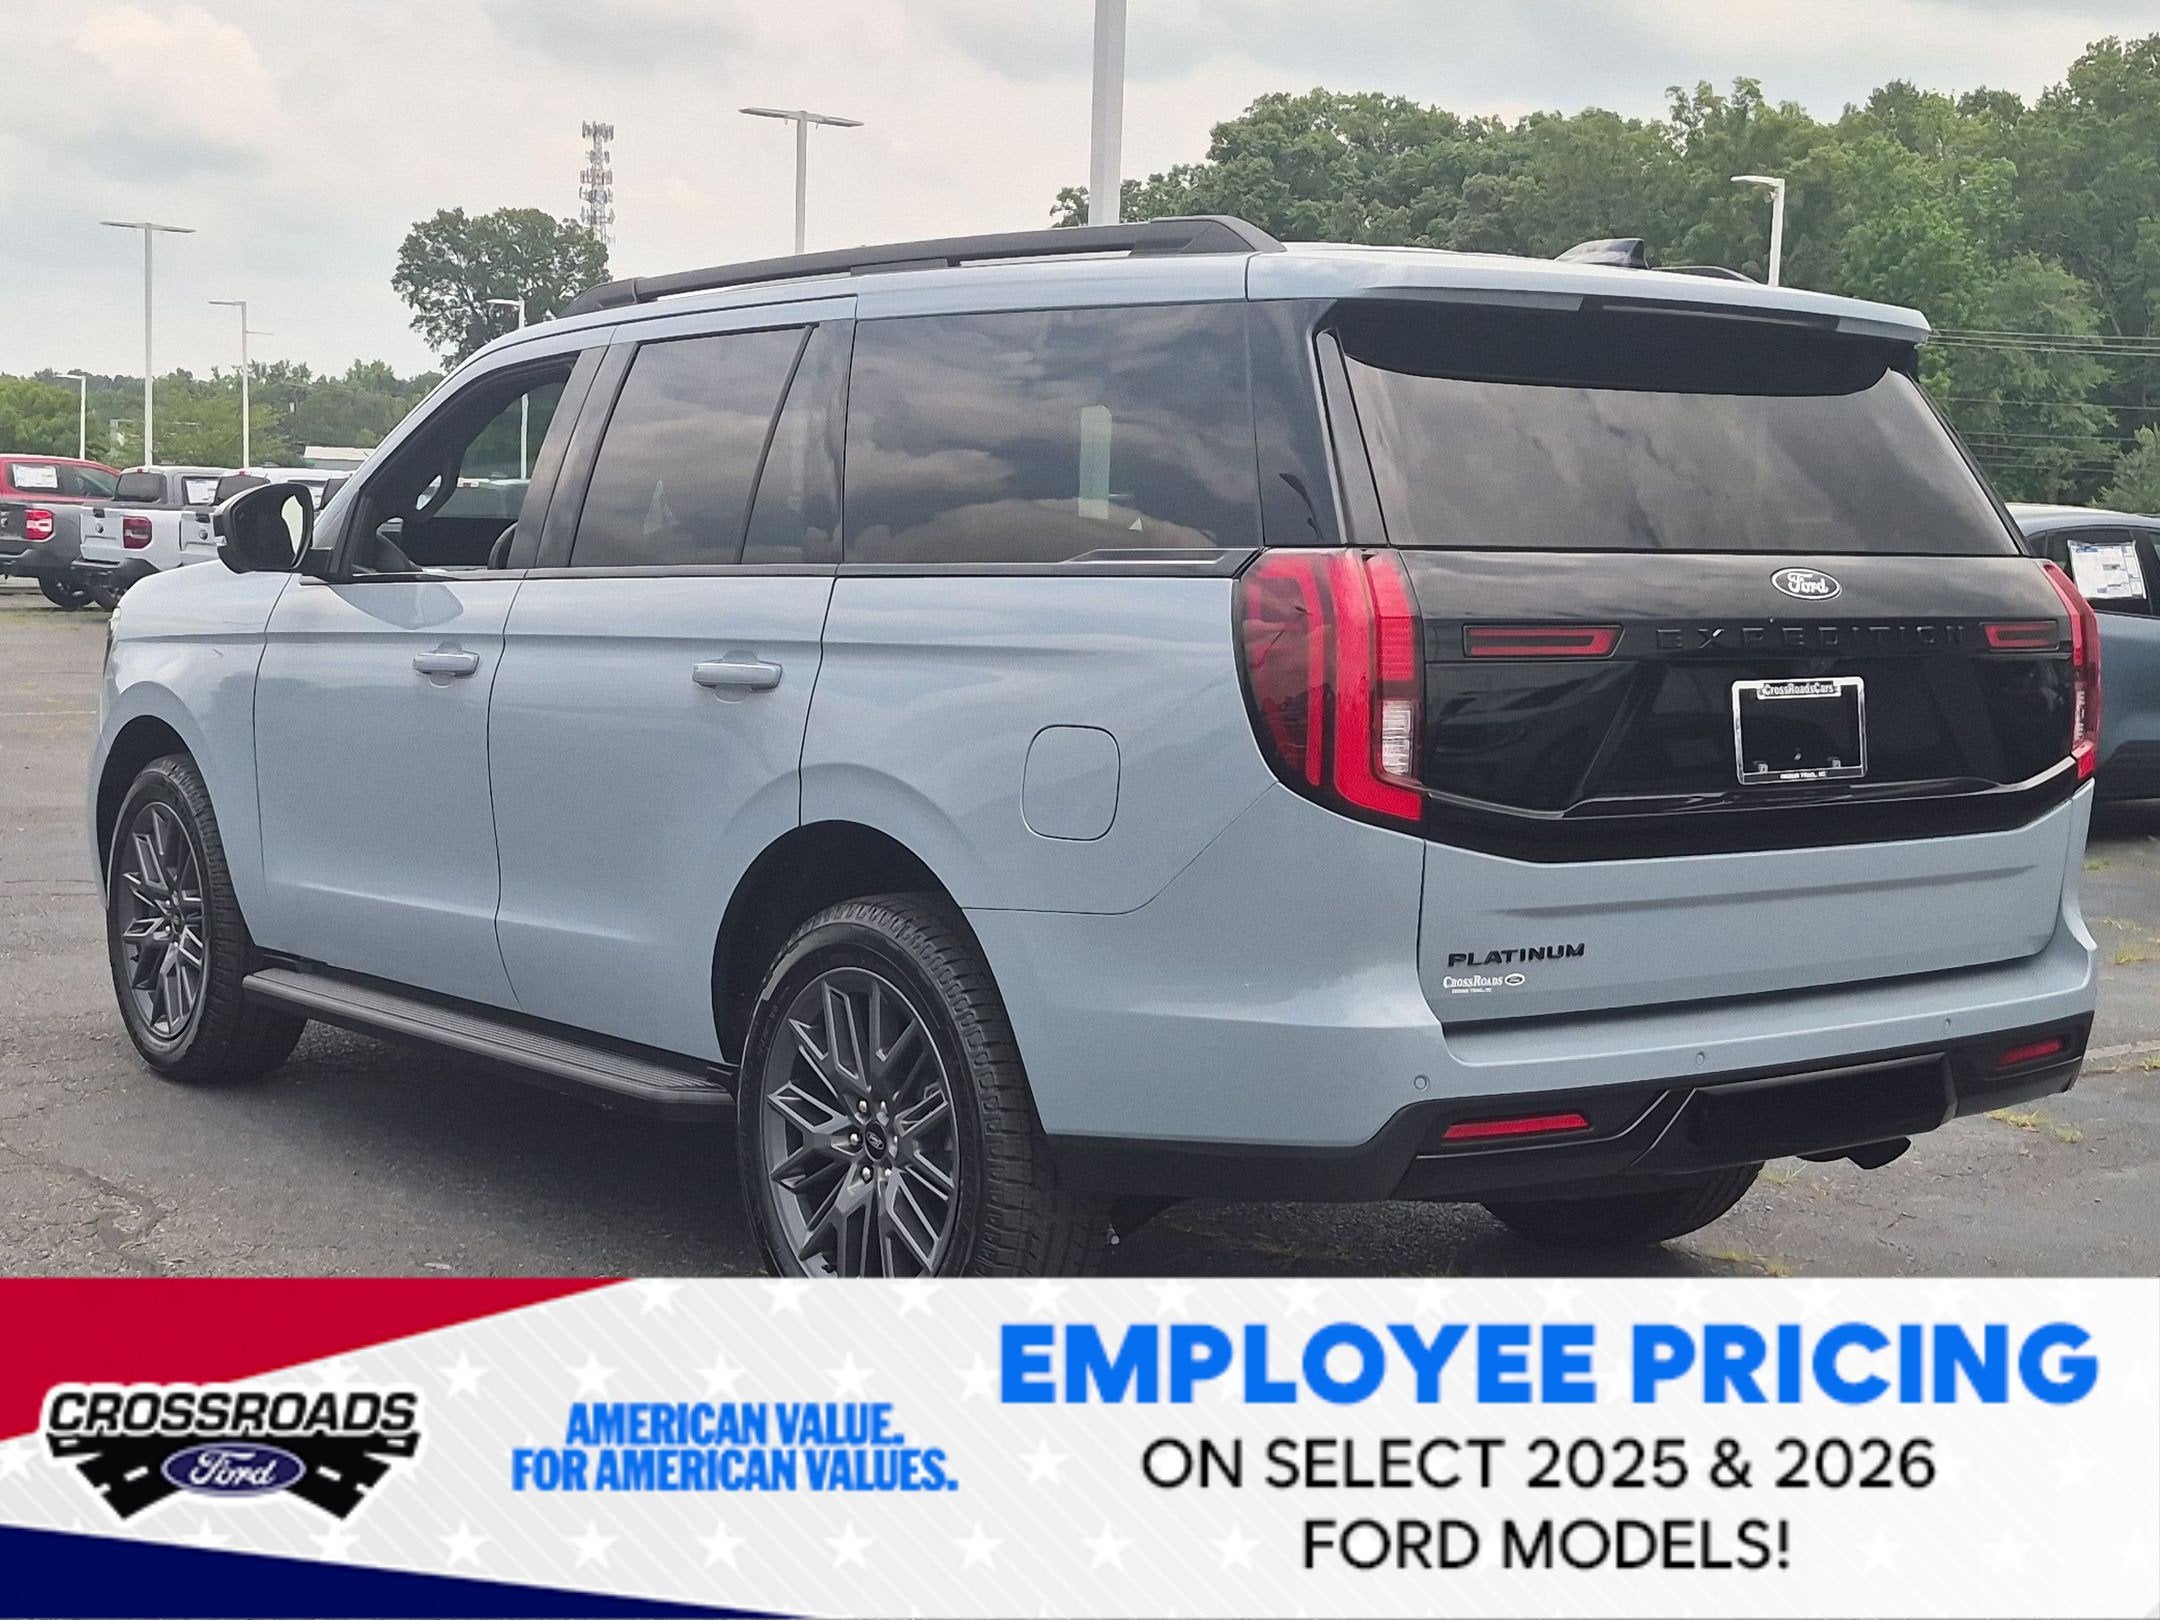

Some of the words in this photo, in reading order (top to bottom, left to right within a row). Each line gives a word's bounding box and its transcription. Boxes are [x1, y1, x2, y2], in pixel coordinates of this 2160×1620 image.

[1787, 572, 1829, 594] Ford
[1656, 625, 1966, 650] EXPEDITION
[1447, 943, 1585, 967] PLATINUM
